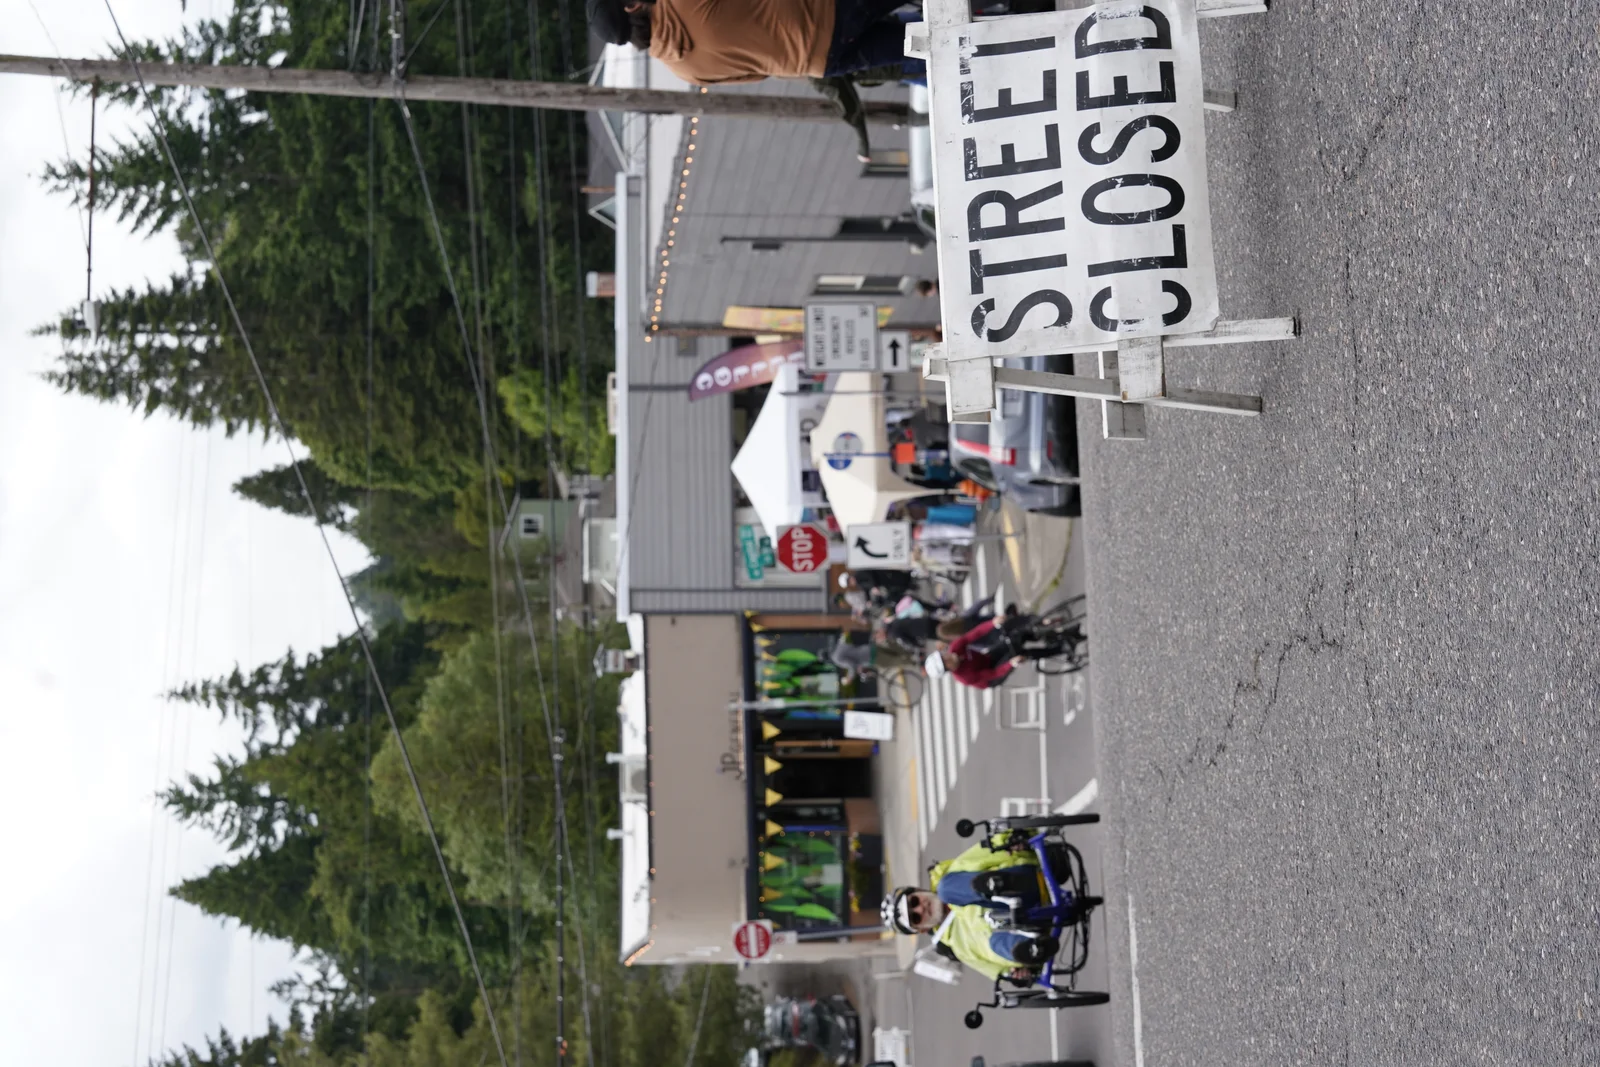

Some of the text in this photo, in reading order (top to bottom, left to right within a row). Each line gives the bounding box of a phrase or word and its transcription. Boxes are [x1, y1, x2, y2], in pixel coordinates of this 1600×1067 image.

[958, 35, 1073, 342] STREET
[1074, 4, 1192, 332] CLOSED
[812, 307, 825, 366] WEIGHT LIMIT
[830, 316, 840, 360] EMERGENCY
[792, 528, 814, 571] STOP
[892, 528, 905, 559] ONLY
